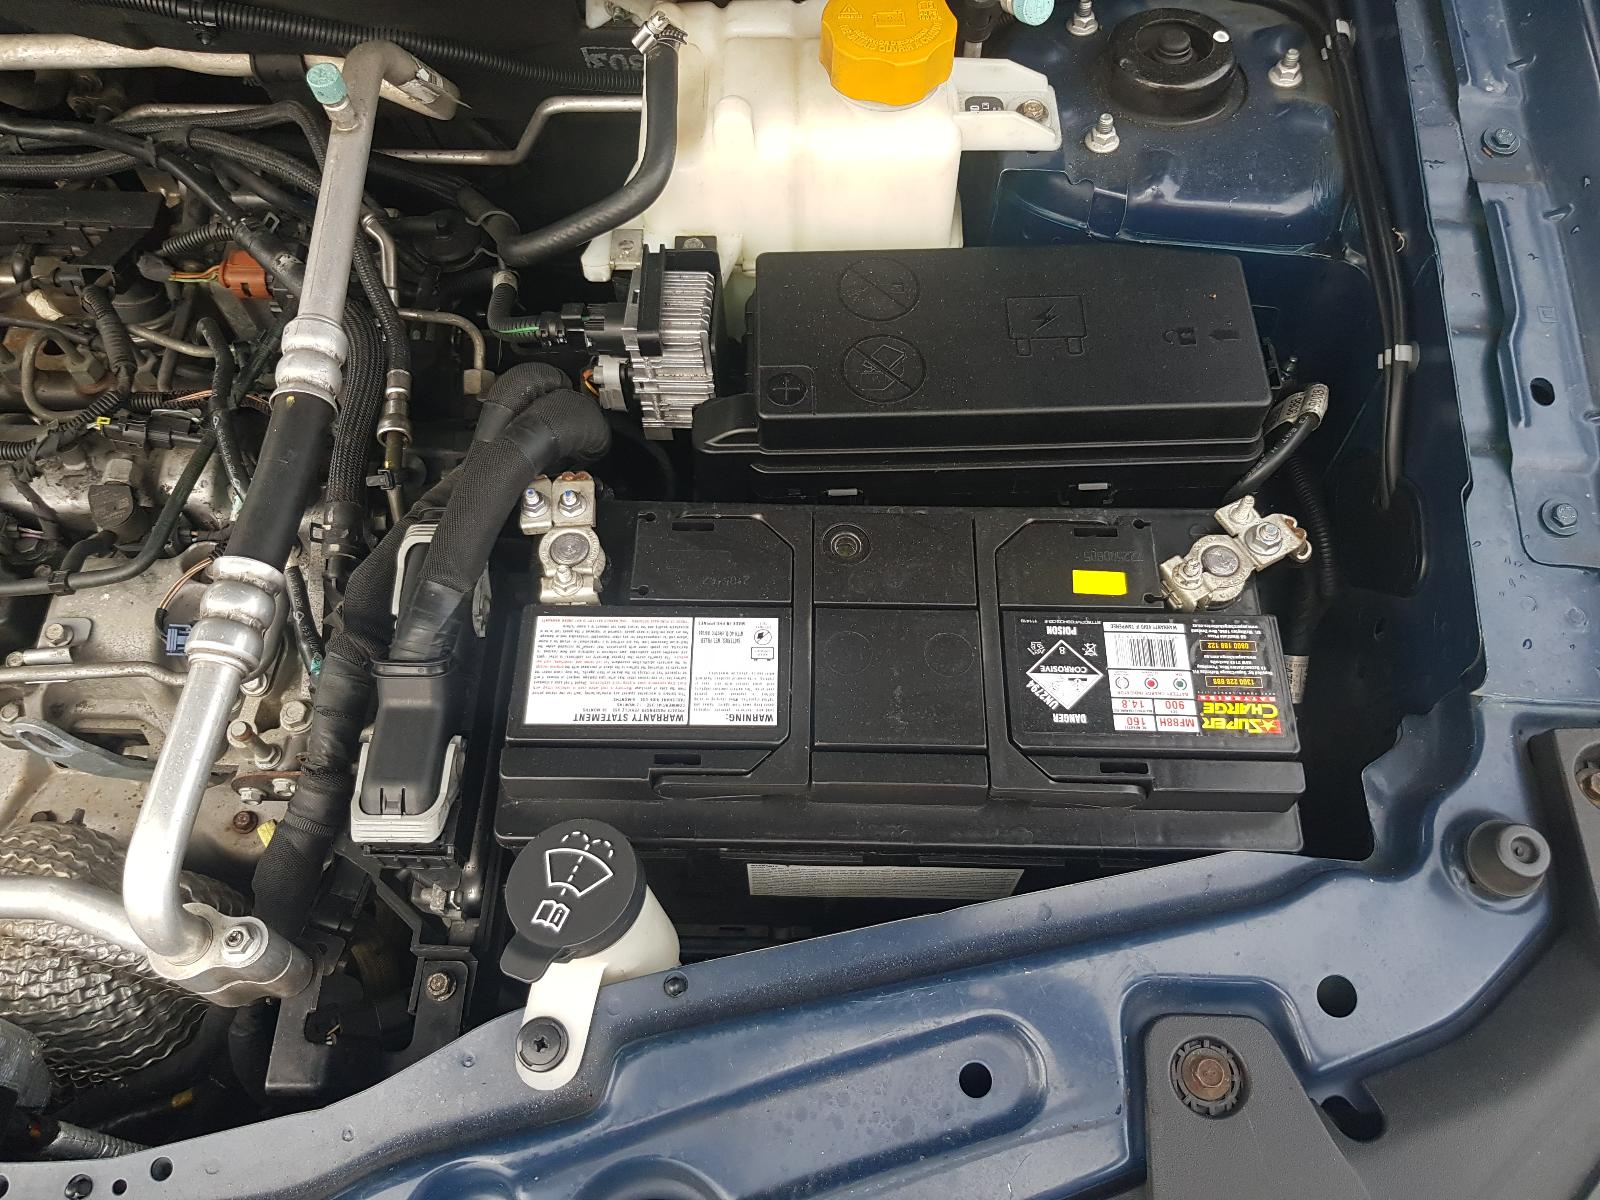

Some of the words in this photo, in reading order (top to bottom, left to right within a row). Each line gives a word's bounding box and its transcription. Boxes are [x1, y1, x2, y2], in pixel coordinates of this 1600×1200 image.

[1046, 626, 1077, 635] POISON
[1059, 646, 1066, 654] 8
[1039, 665, 1087, 673] CORROSIVE
[1026, 680, 1059, 710] UN2794
[1122, 700, 1144, 708] 14.8
[1165, 701, 1184, 709] 900
[1203, 702, 1278, 718] CHARGE
[573, 713, 628, 721] STATEMENT
[632, 714, 684, 722] WARRANTY
[726, 714, 773, 722] WARNING:
[1053, 713, 1087, 723] DANGER
[1127, 717, 1145, 725] 160
[1160, 718, 1195, 727] MF88H
[1202, 716, 1264, 734] SUPER
